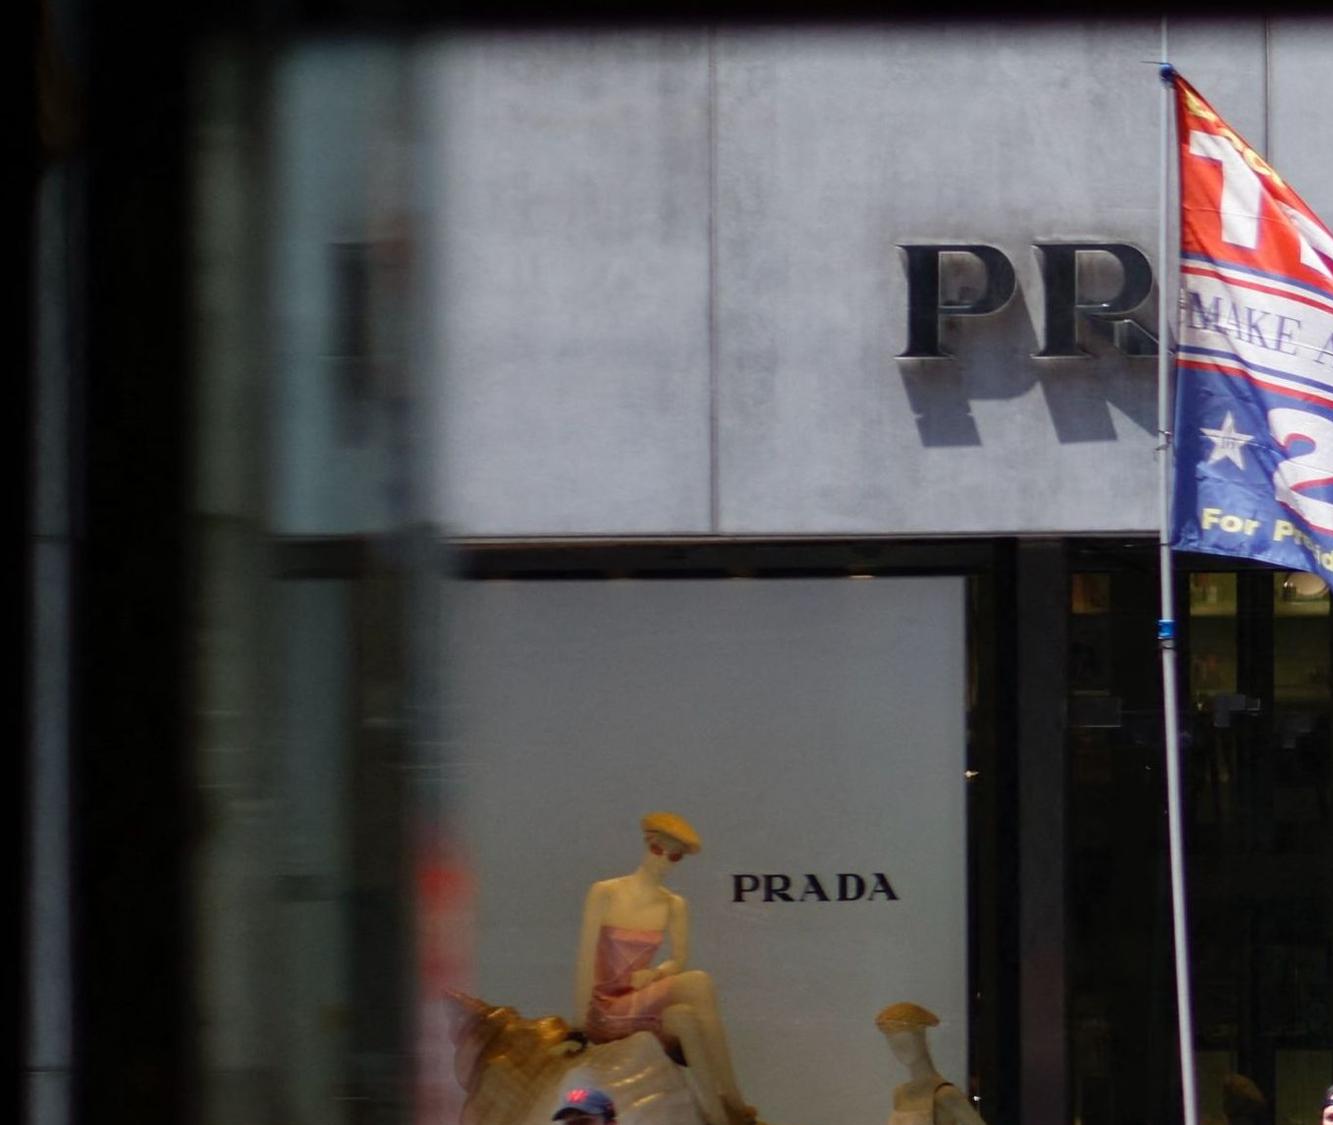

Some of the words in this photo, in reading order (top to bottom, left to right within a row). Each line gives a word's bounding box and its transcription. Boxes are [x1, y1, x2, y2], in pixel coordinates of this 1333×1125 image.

[1188, 291, 1301, 356] MAKE
[1201, 507, 1260, 536] For
[732, 872, 900, 902] PRADA
